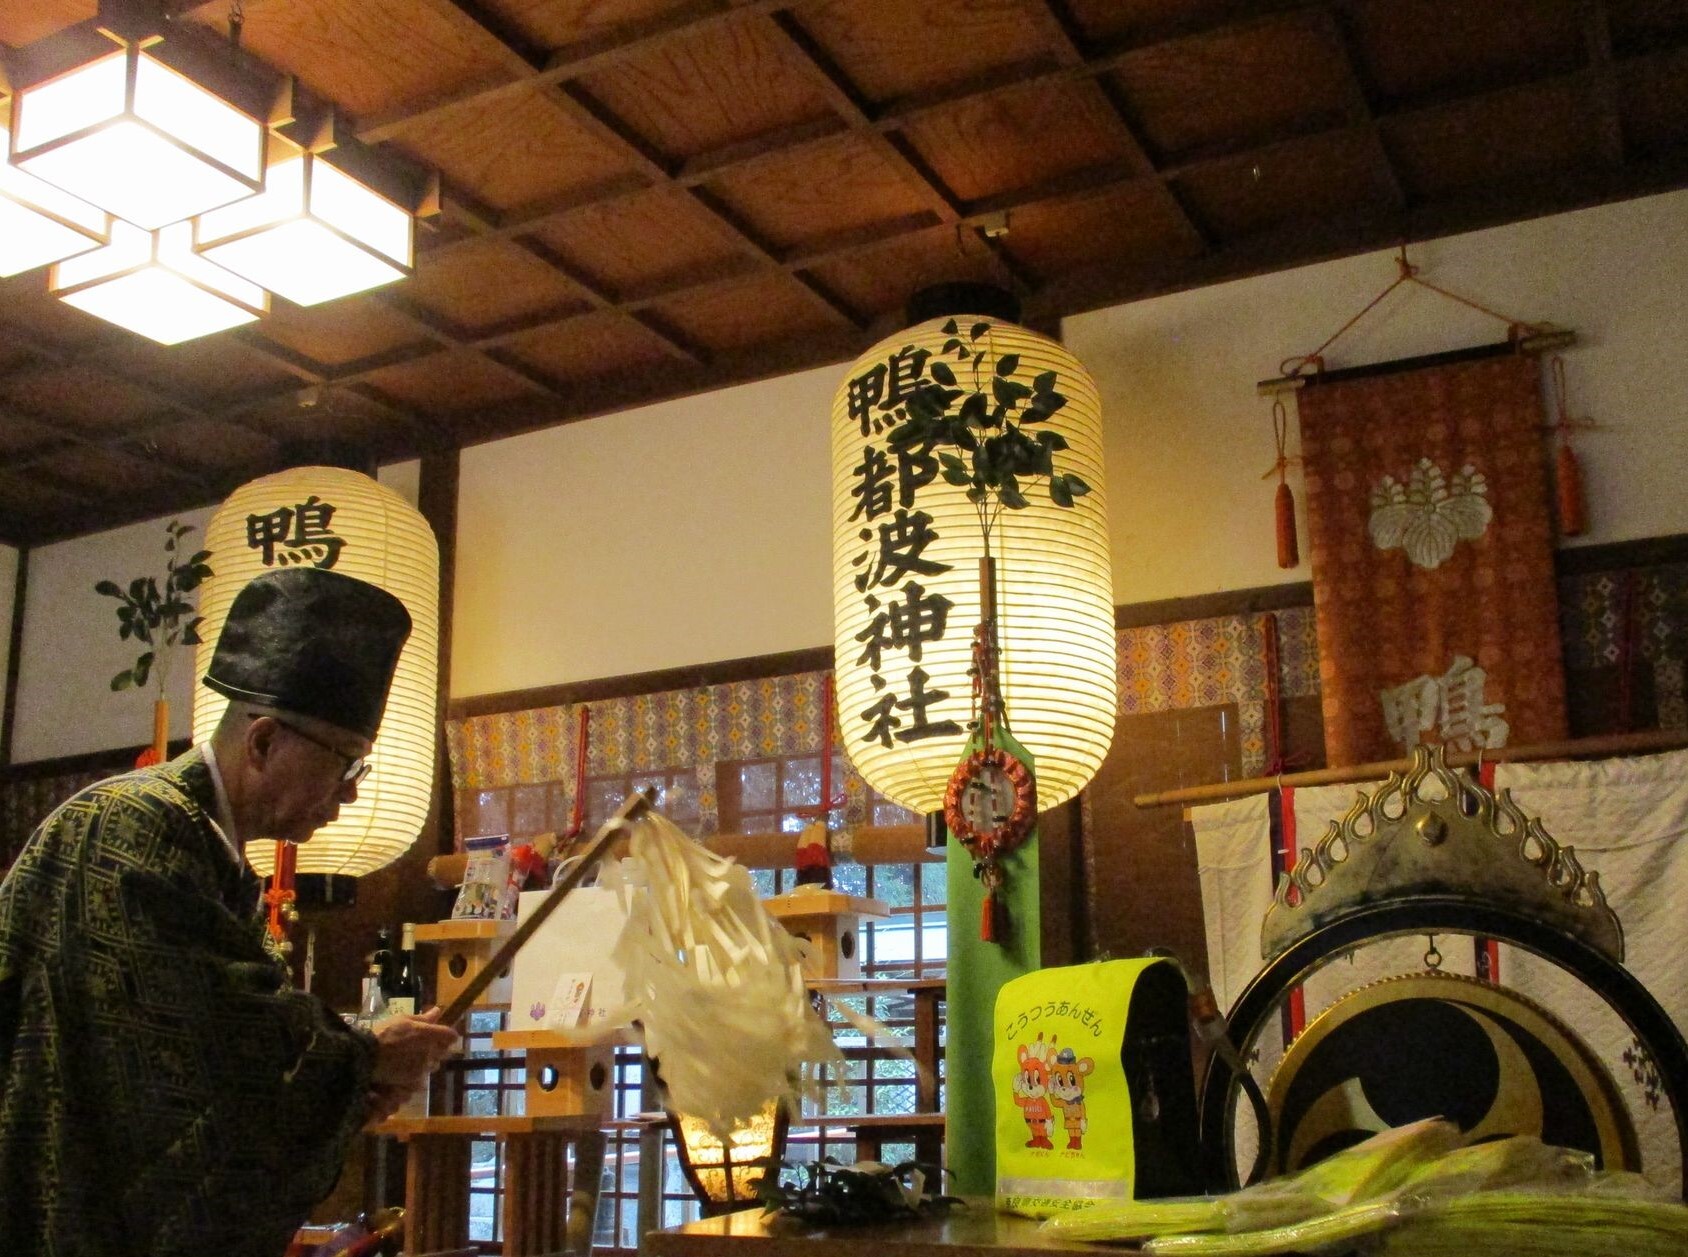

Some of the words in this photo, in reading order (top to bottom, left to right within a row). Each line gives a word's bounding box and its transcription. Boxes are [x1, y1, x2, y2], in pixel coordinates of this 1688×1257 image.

[247, 496, 347, 570] 鴨
[848, 344, 963, 748] 鴨都波神社
